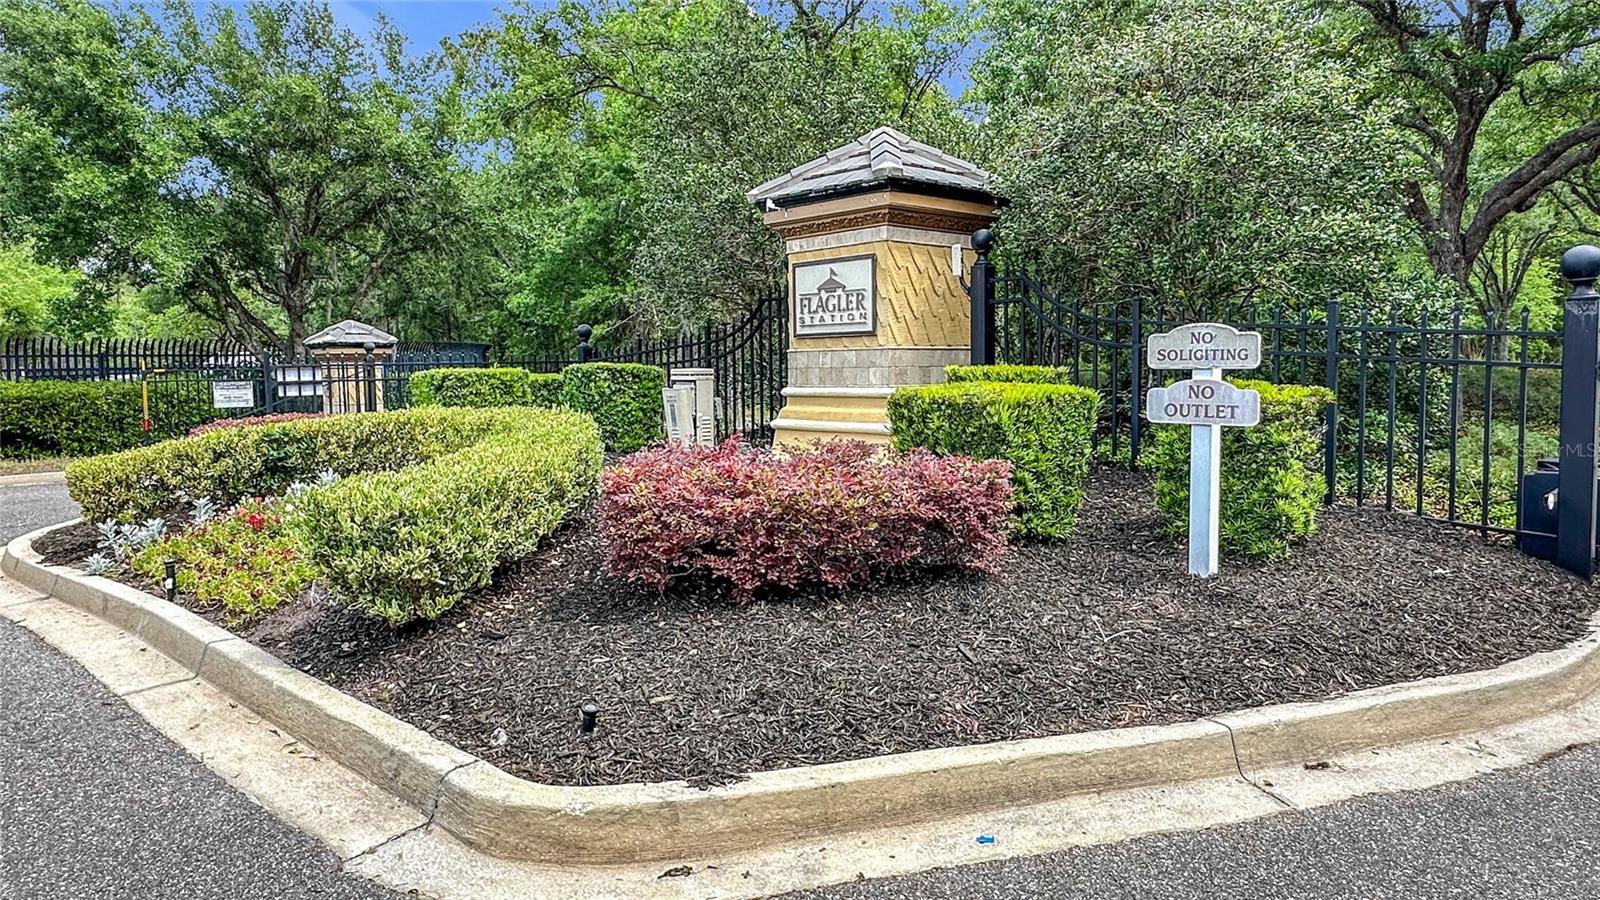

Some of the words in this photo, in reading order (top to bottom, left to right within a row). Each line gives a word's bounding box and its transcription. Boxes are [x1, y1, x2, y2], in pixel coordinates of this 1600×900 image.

[799, 292, 867, 315] FLAGLER
[798, 312, 868, 325] STATION
[1190, 332, 1214, 345] NO
[1157, 348, 1249, 361] SOLICITING
[1188, 385, 1215, 399] NO
[1163, 403, 1239, 420] OUTLET
